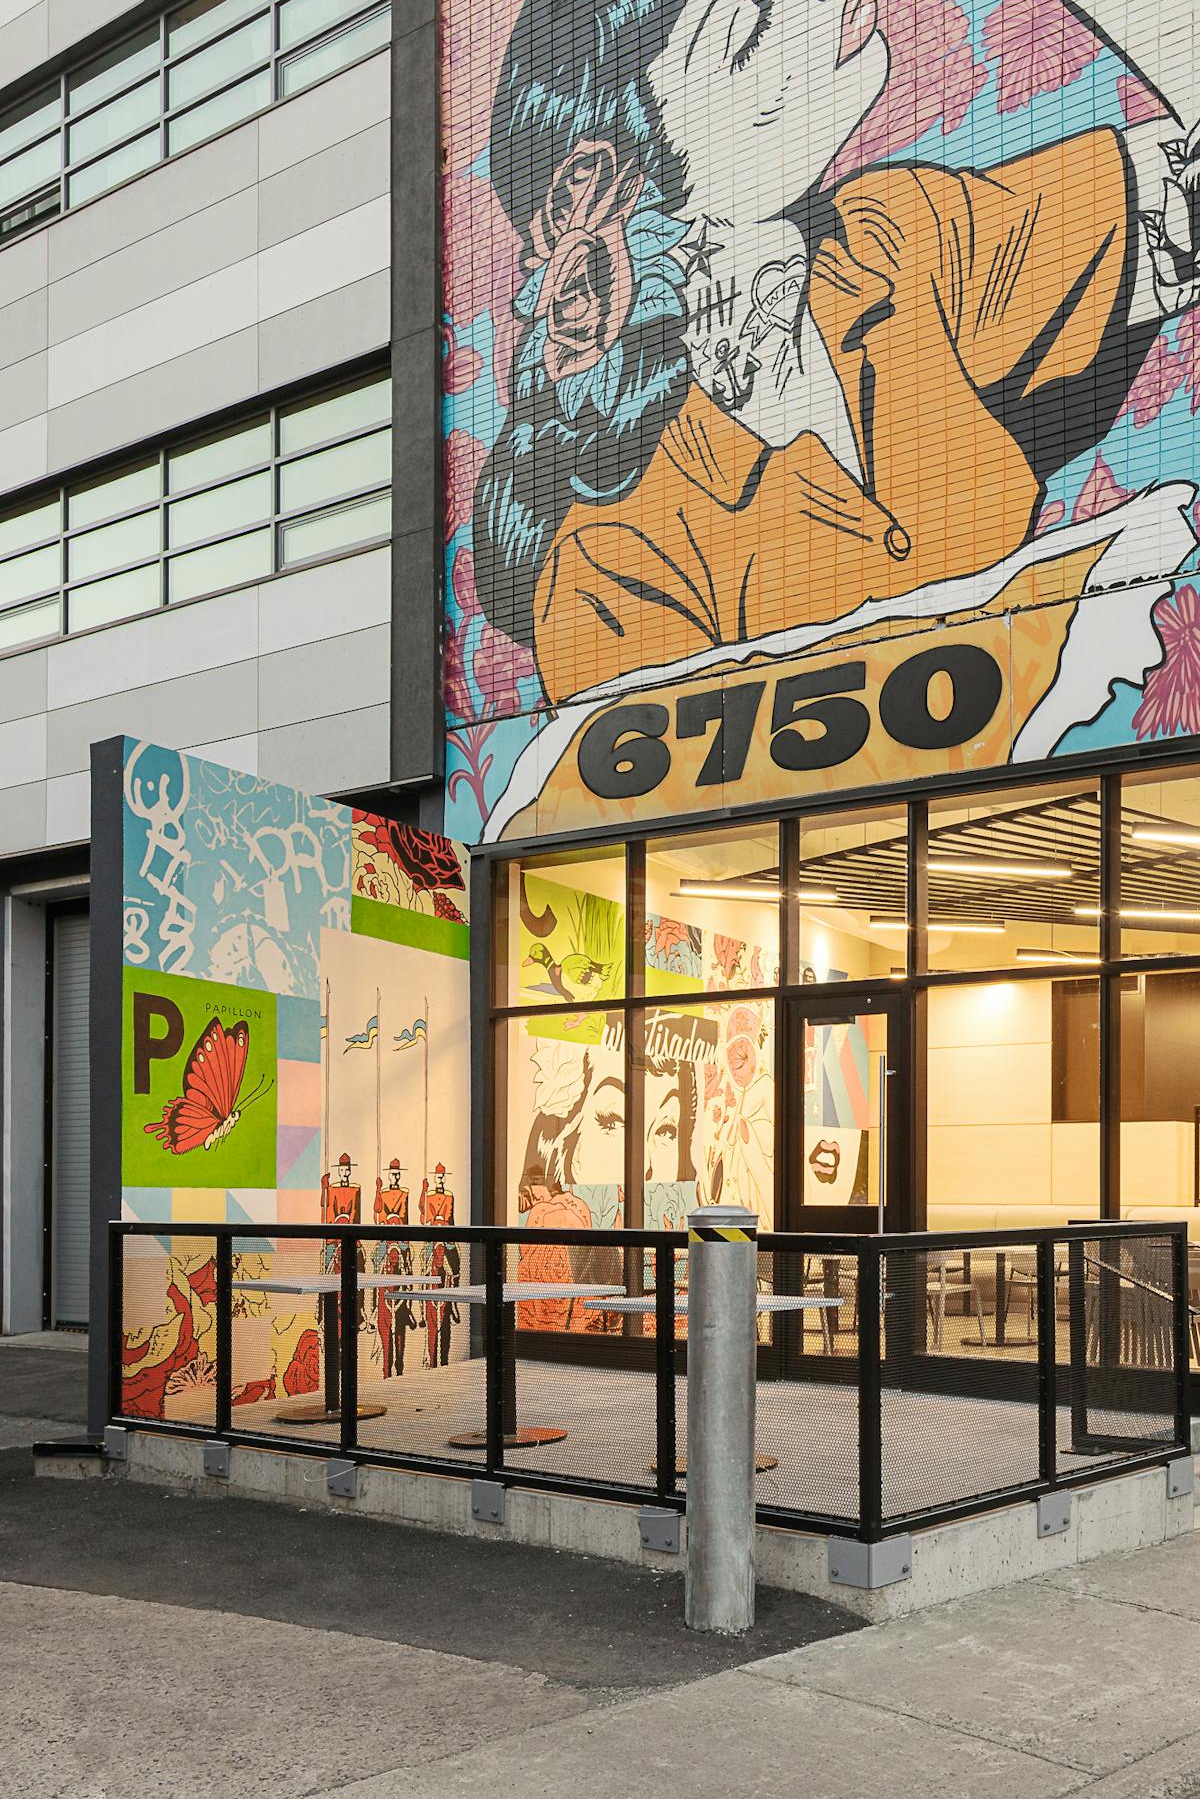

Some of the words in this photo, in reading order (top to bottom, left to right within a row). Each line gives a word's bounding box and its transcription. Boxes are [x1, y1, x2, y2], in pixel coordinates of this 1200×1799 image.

[766, 279, 800, 306] WIA
[577, 644, 1003, 799] 6750
[133, 991, 185, 1095] P
[205, 1002, 261, 1019] PAPILLON
